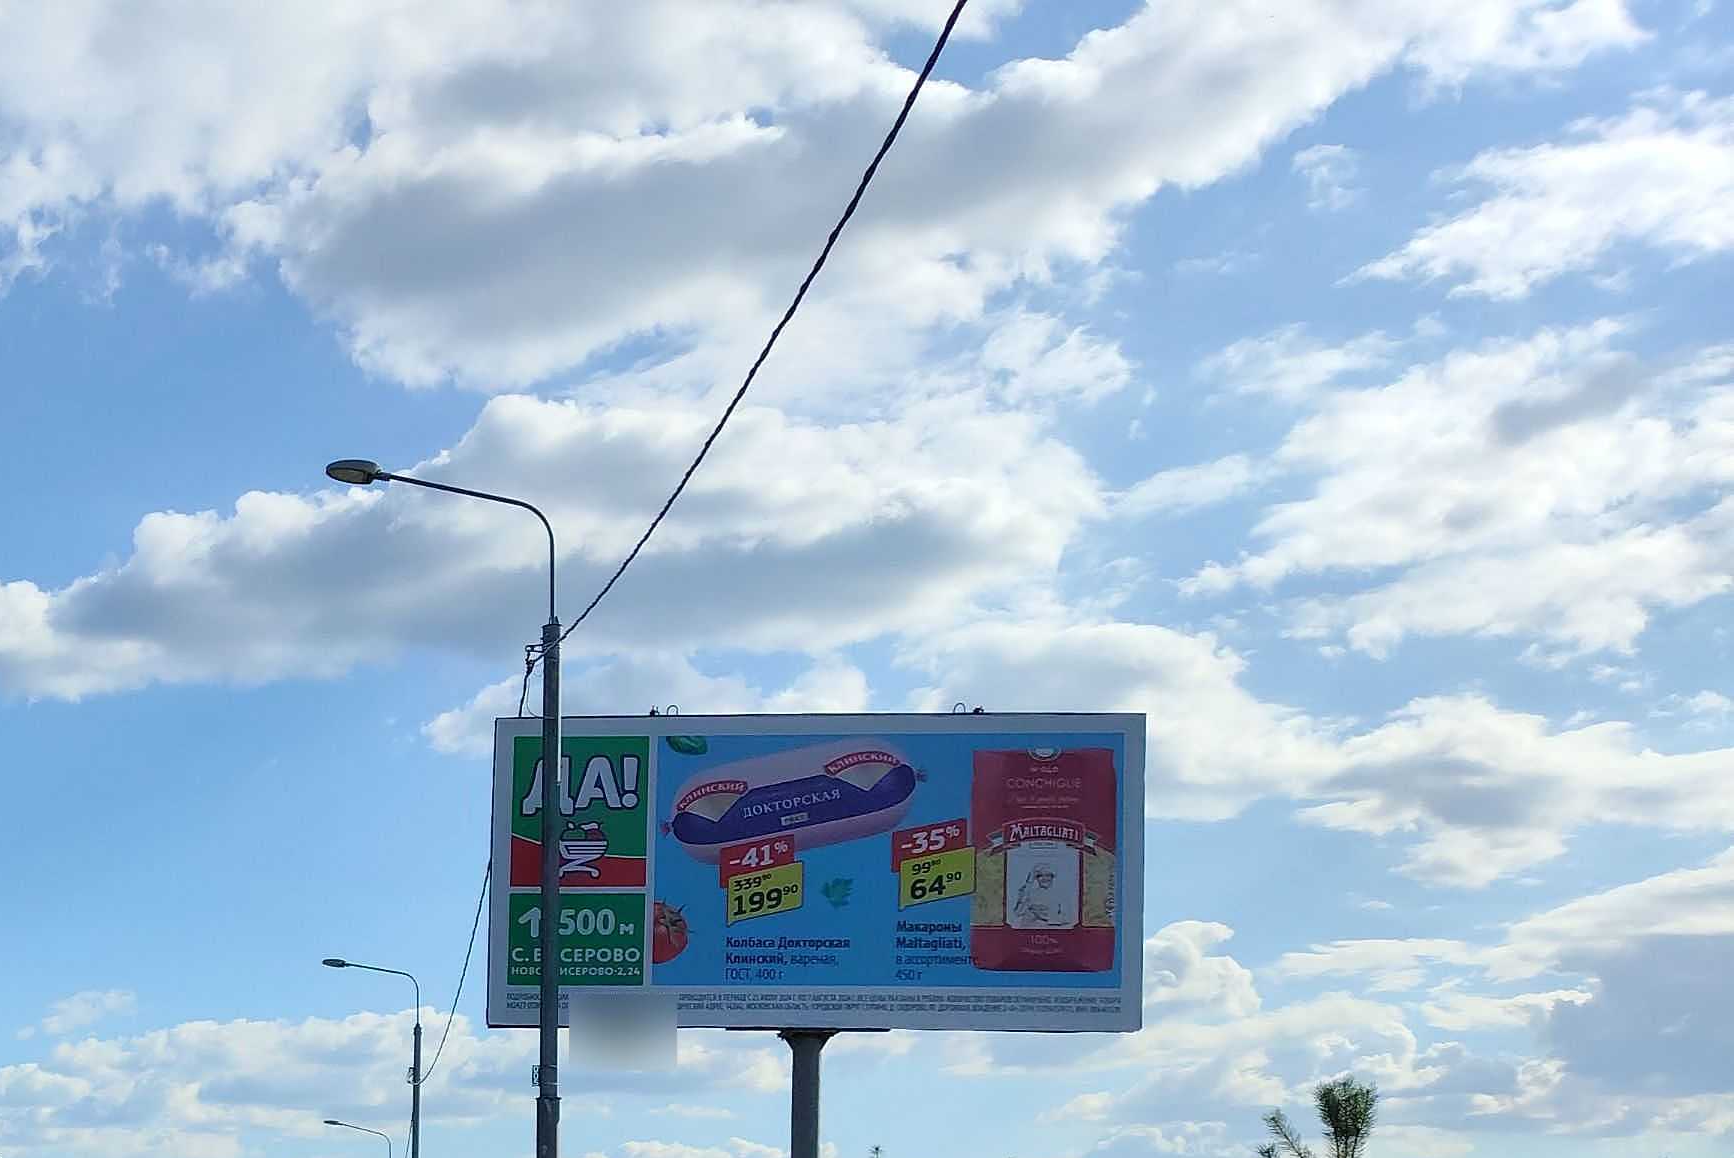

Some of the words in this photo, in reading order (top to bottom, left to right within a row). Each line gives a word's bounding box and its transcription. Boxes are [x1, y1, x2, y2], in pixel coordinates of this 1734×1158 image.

[742, 788, 843, 819] ДОКТОРСКАЯ
[558, 908, 616, 936] 500
[896, 920, 963, 935] Макароны
[725, 936, 775, 948] Колбаса
[777, 936, 850, 950] Докторская
[725, 952, 788, 967] Клинский,
